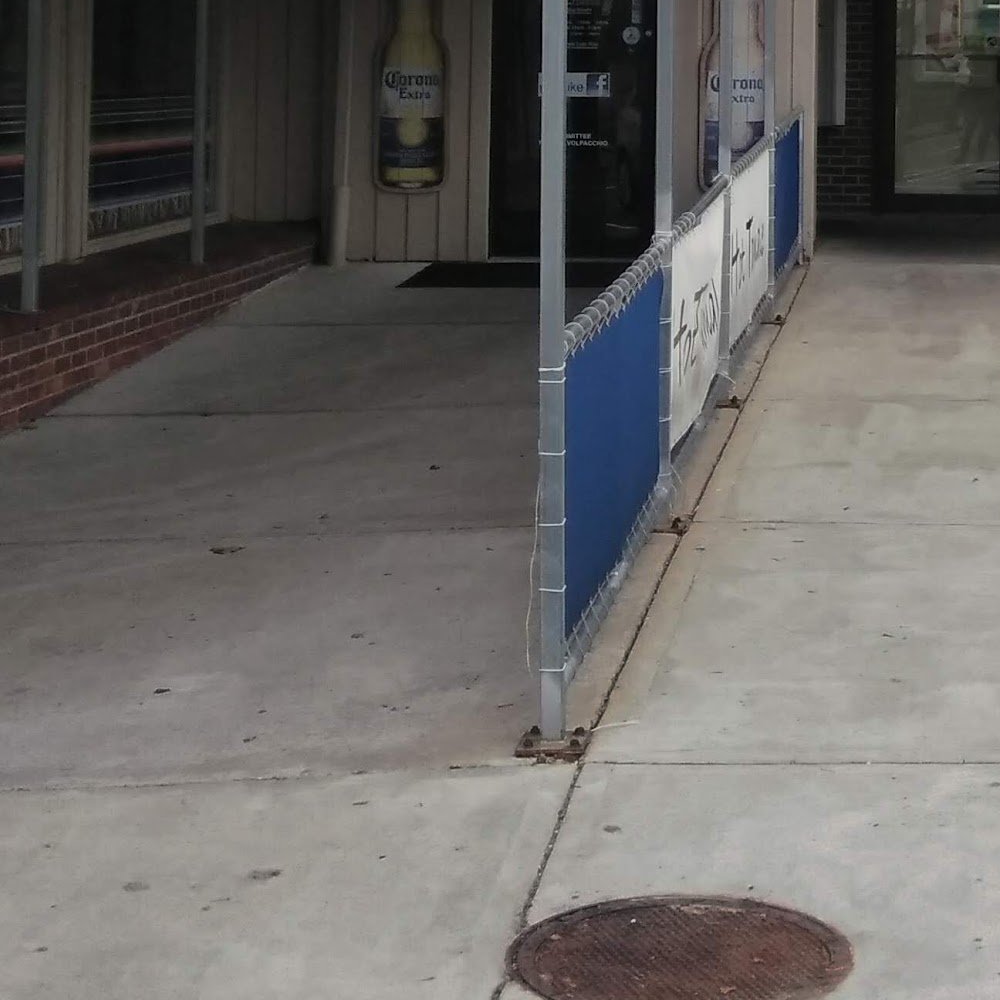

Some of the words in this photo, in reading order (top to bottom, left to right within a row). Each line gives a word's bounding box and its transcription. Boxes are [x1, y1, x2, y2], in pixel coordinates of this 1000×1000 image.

[384, 69, 441, 89] Corona
[710, 74, 764, 93] Crona
[398, 87, 432, 99] Extra
[732, 94, 755, 104] xtra
